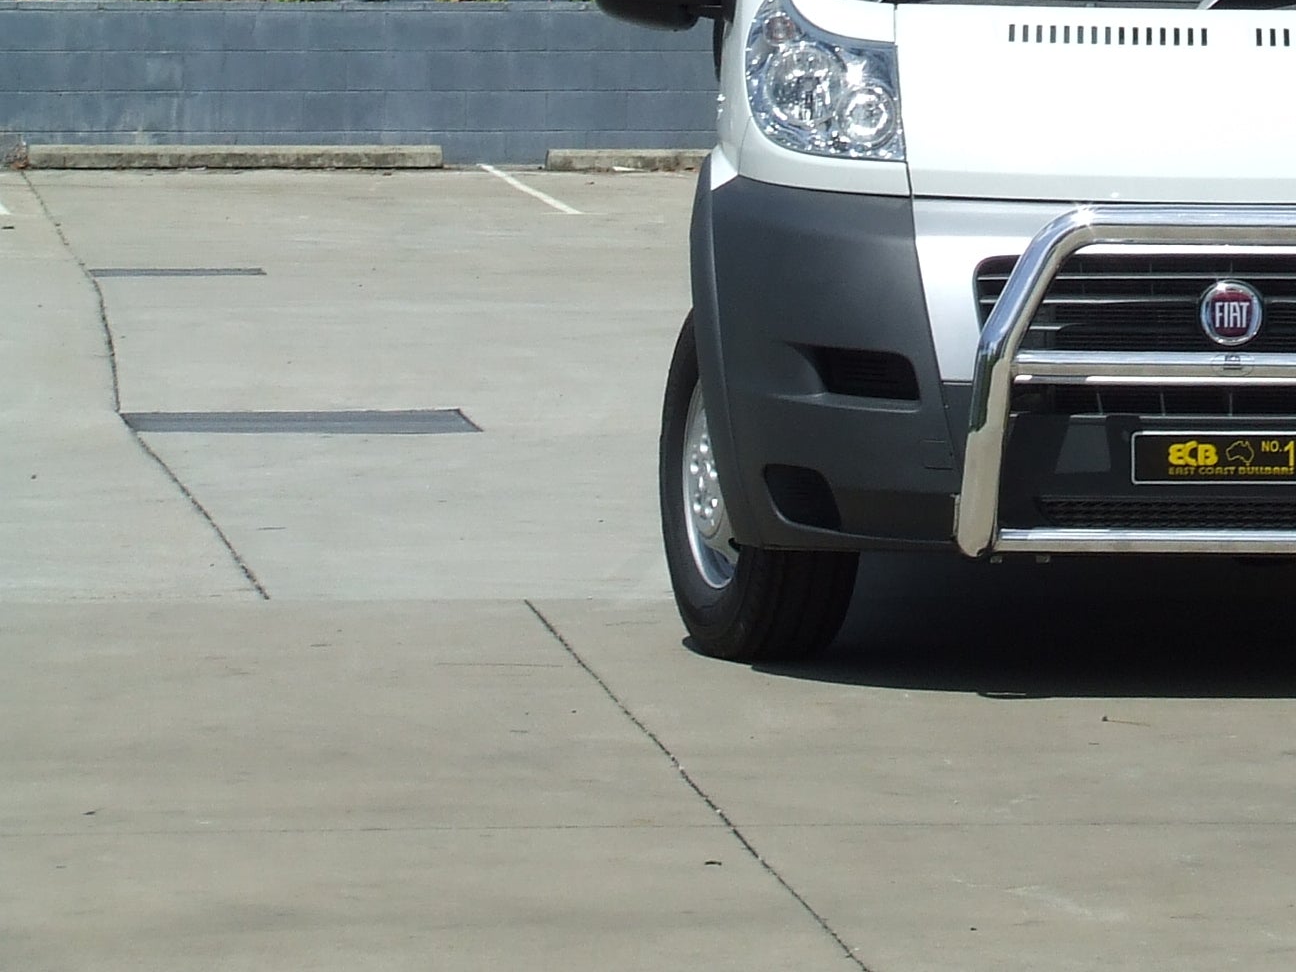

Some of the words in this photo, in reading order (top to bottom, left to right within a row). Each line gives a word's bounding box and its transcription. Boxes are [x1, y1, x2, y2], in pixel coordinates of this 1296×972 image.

[1215, 301, 1249, 328] FIAT
[1168, 440, 1219, 467] ECB
[1168, 466, 1195, 475] EAST
[1199, 466, 1235, 475] COAST
[1238, 466, 1295, 475] BULLBARS
